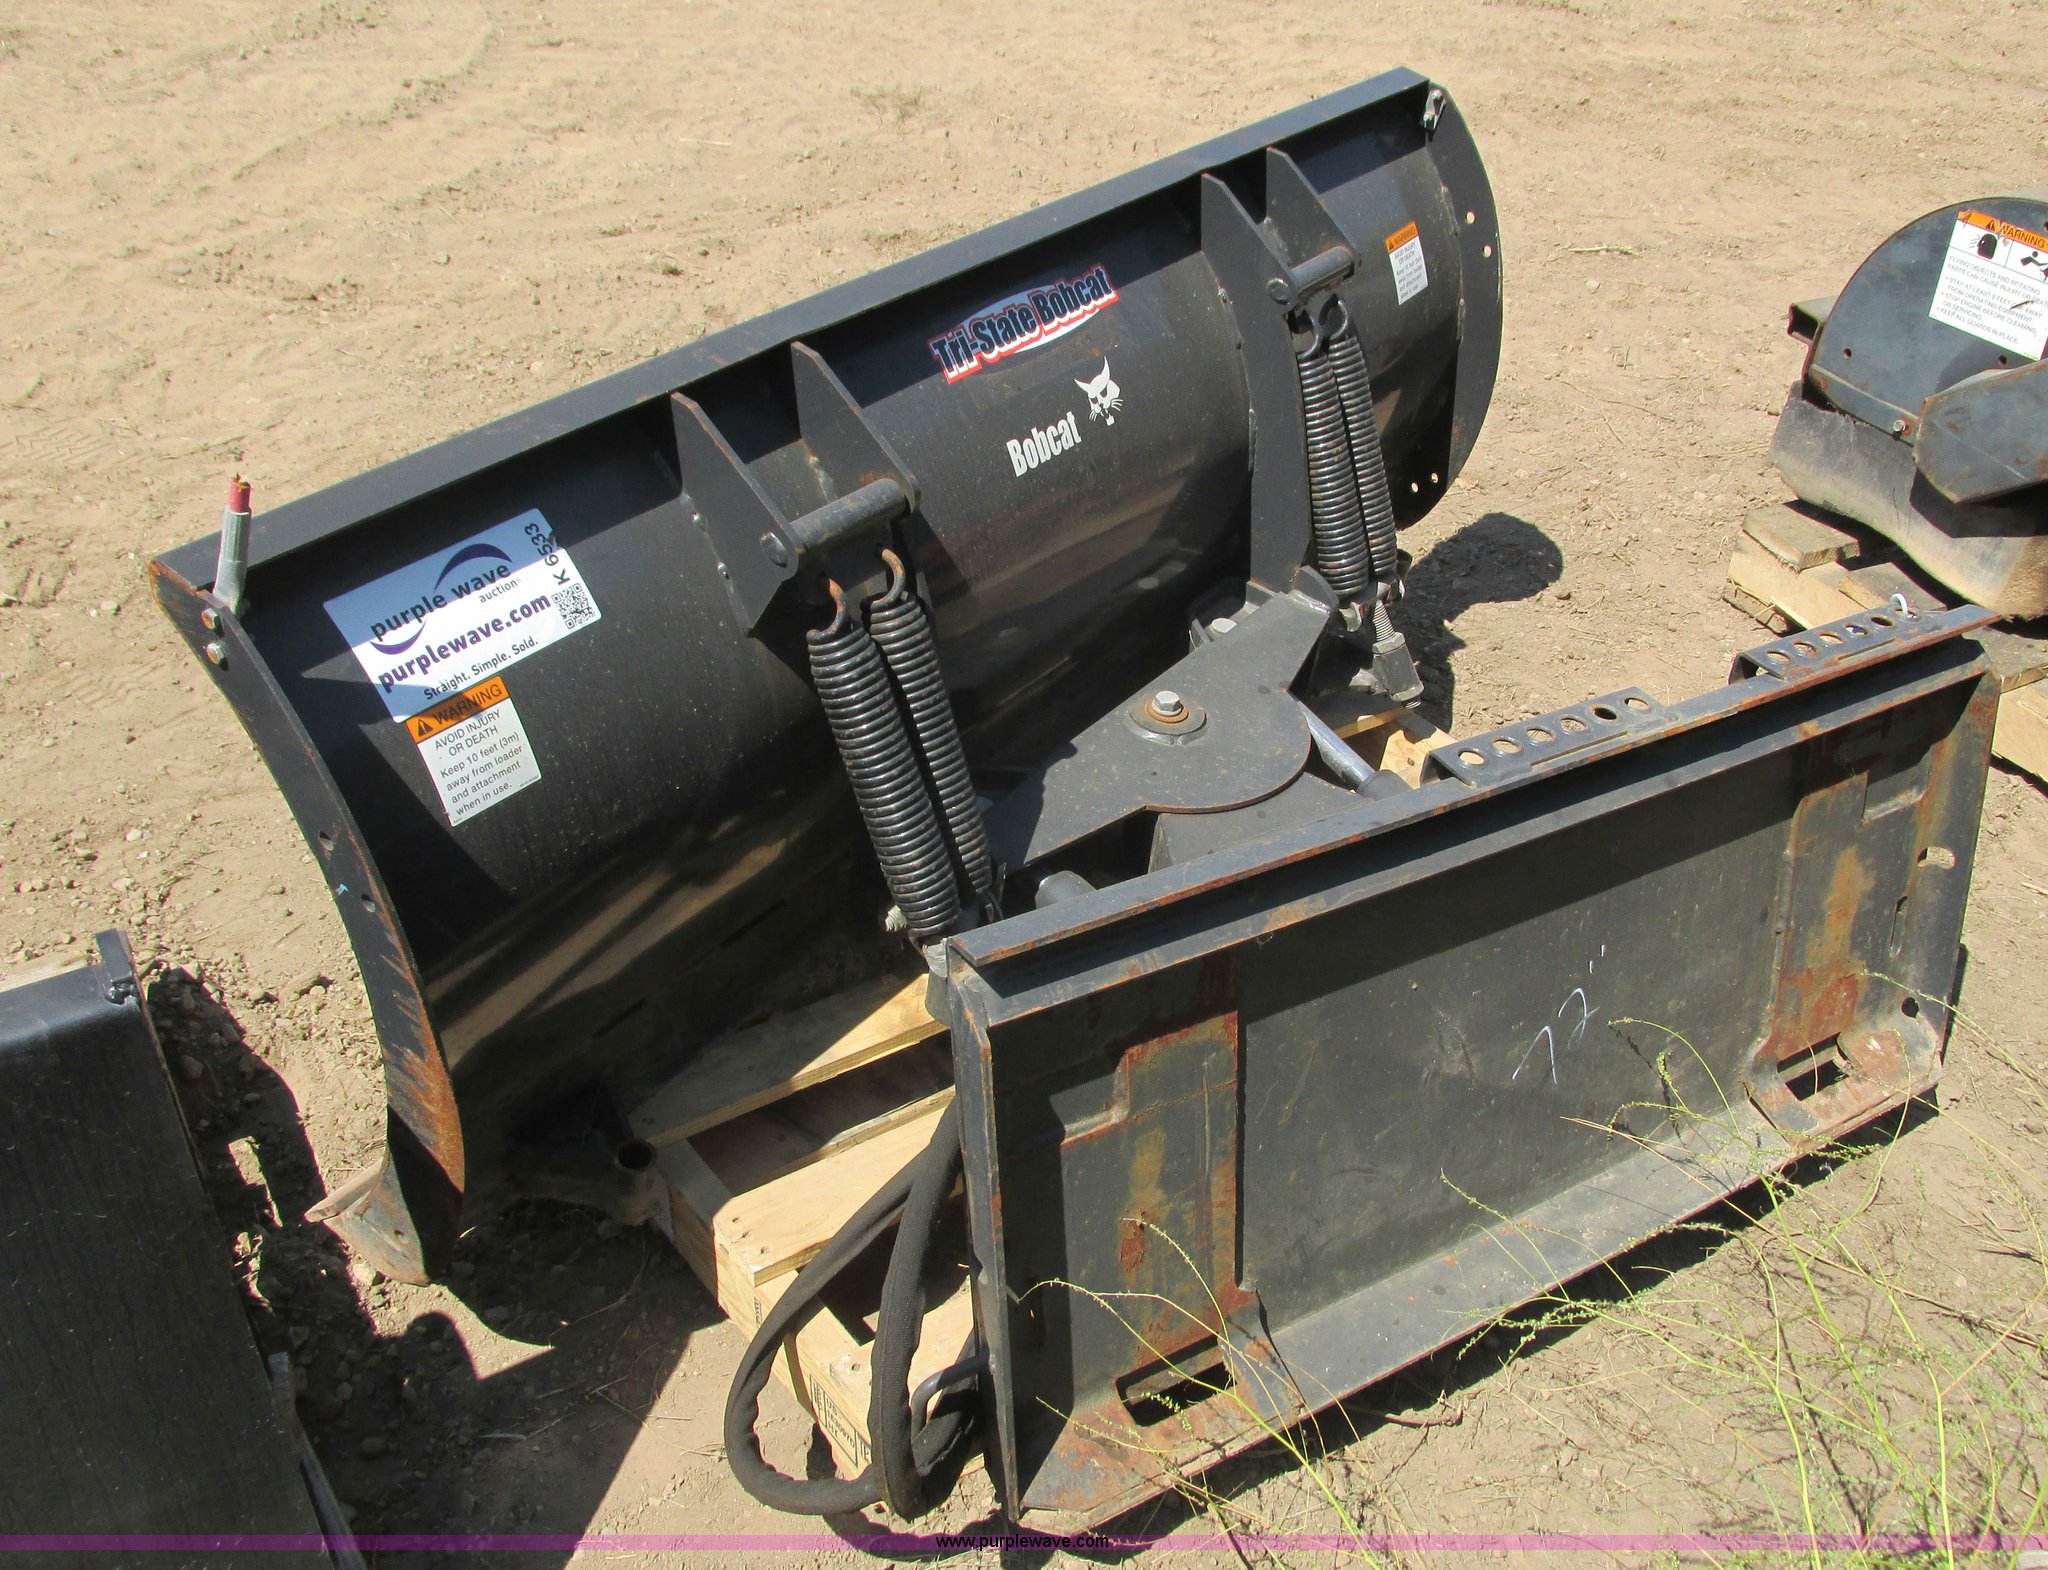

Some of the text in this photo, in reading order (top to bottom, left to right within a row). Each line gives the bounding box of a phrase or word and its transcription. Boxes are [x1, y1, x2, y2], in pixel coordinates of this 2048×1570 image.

[2000, 225, 2046, 249] WARNING
[1947, 263, 1966, 275] PARTS
[1967, 269, 1979, 280] CAN
[1980, 275, 1999, 288] CAUSE
[2000, 284, 2021, 297] INJURY
[1950, 255, 2041, 296] FLYING OBJECTS AND ROTATING
[1944, 292, 1960, 303] STOP
[1960, 298, 1982, 313] ENGINE
[1983, 308, 2006, 321] BEFORE
[1948, 285, 1965, 296] FROM
[1965, 290, 1998, 309] OPERATING
[1949, 277, 1963, 287] STAY
[1973, 285, 1991, 298] LEAST
[1996, 295, 2011, 306] FEET
[2025, 307, 2043, 318] AWAY
[930, 267, 1115, 378] Tri-State Bobcat
[1956, 313, 1967, 323] ALL
[1967, 318, 1991, 333] GUARDS
[1992, 327, 1998, 336] IN
[1006, 411, 1082, 477] Bobcat
[524, 523, 570, 586] K 6533
[371, 564, 511, 641] purple wave
[378, 595, 551, 694] purplewave.com
[423, 636, 539, 700] Straight. Simple. Sold.
[433, 684, 502, 725] WARNING
[435, 709, 501, 750] AVOID INJURY
[448, 725, 498, 757] OR DEATH
[440, 732, 519, 779] Keep 10 feet (3m)
[446, 745, 523, 792] away from loader
[452, 789, 469, 804] and
[471, 761, 521, 793] attachment
[455, 799, 480, 816] when
[482, 790, 491, 802] in
[492, 781, 512, 796] use.
